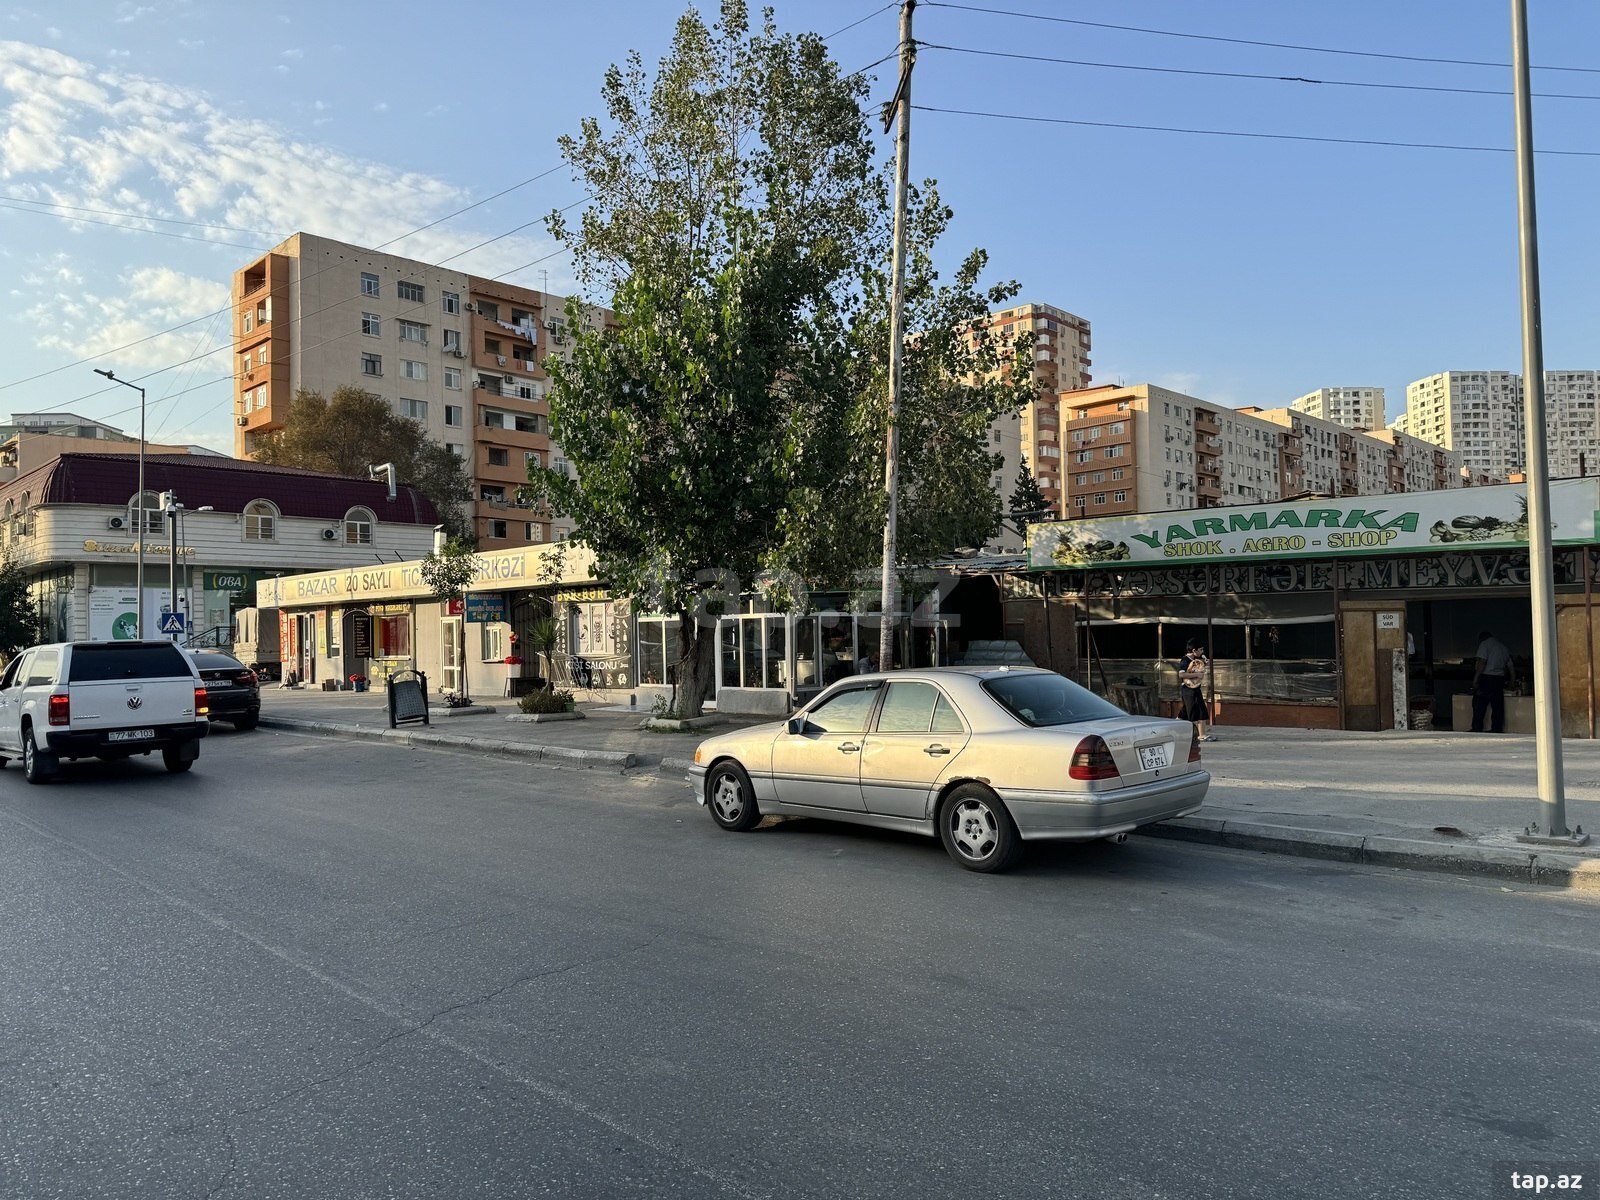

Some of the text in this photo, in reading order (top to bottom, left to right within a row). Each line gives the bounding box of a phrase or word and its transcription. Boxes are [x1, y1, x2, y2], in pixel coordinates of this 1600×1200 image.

[1130, 508, 1420, 549] YARMARKA
[1163, 540, 1224, 557] SHOK
[1242, 535, 1306, 553] AGRO
[1327, 530, 1398, 548] SHOP
[218, 576, 242, 587] OBA
[297, 576, 338, 597] BAZAR
[345, 575, 359, 592] 20
[362, 570, 392, 591] SAYLI
[585, 660, 617, 670] SALONU
